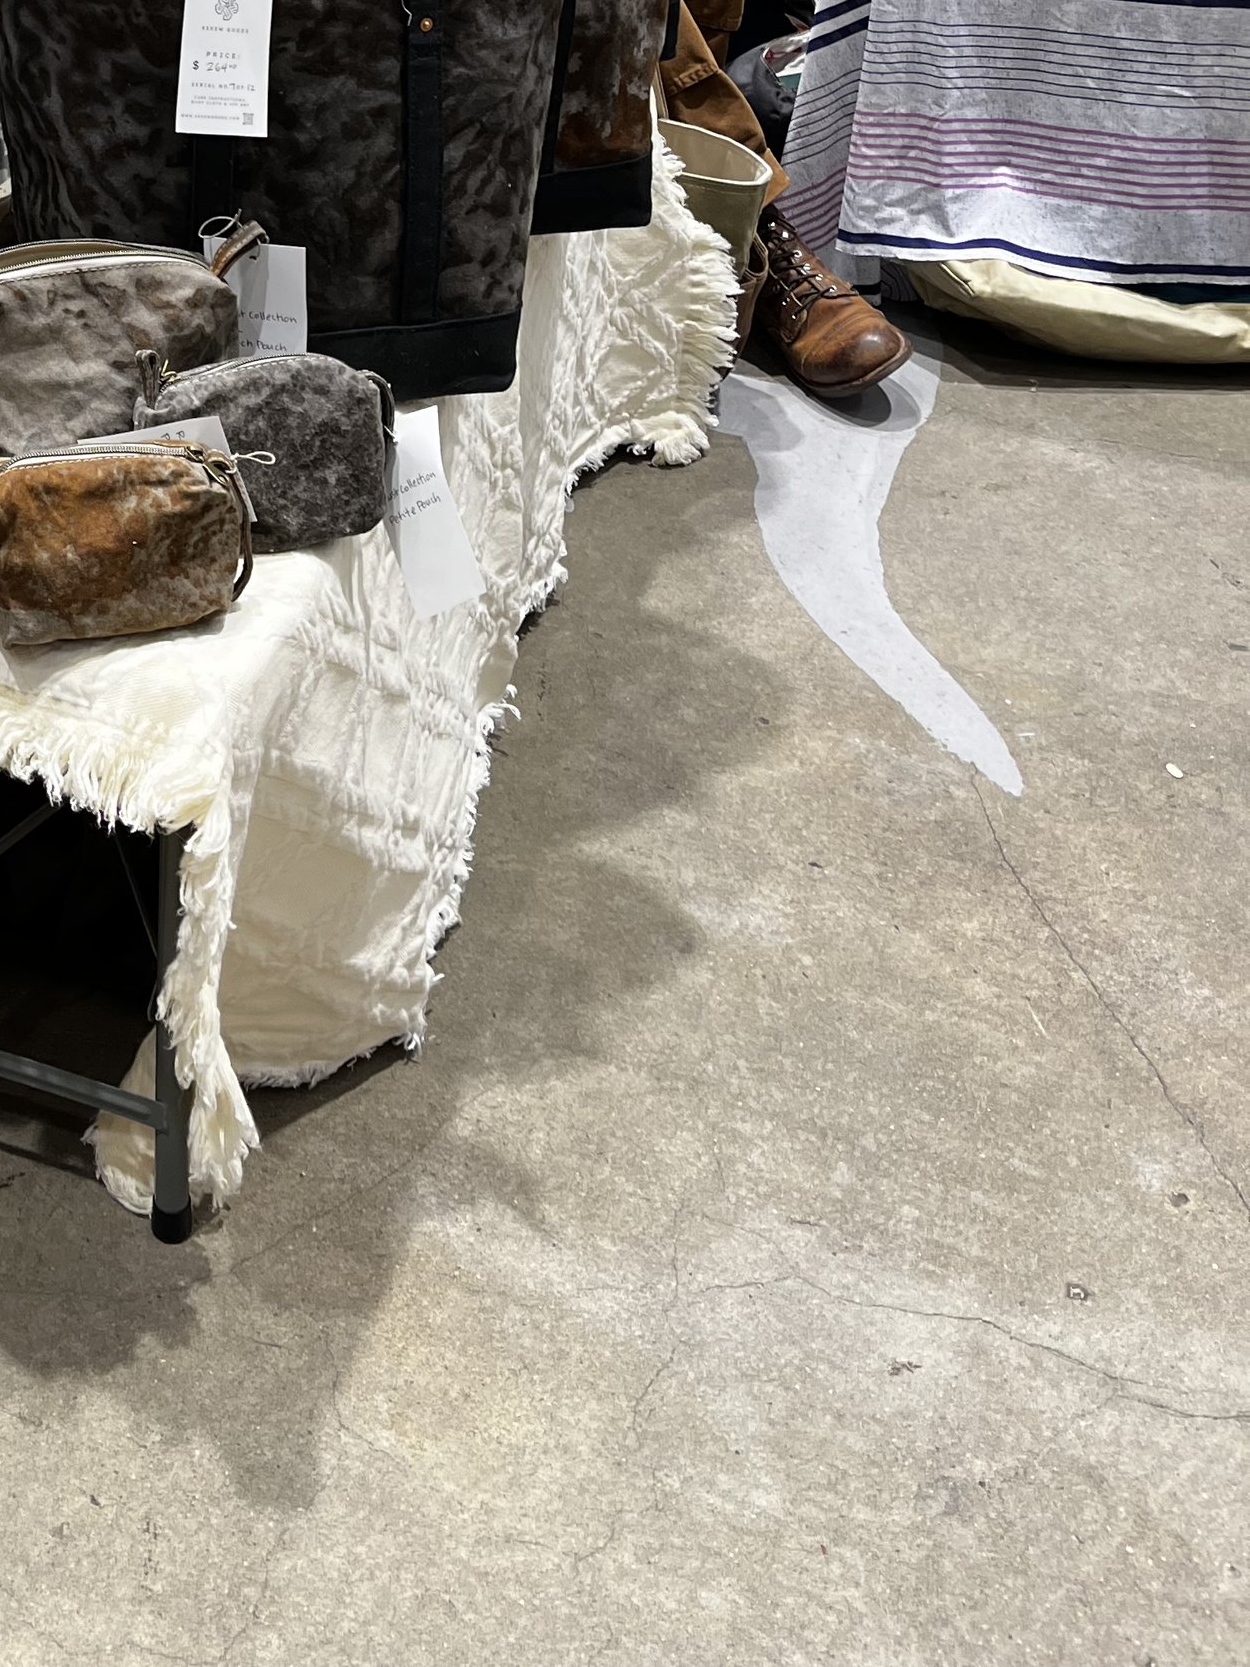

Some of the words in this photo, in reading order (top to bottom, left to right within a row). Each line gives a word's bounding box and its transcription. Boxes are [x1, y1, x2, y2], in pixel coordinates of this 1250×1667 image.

[192, 60, 200, 71] $
[248, 310, 298, 324] Collection
[256, 339, 287, 352] Pouch
[399, 471, 437, 495] Collection
[388, 506, 417, 526] Petite
[416, 491, 441, 512] Pouch
